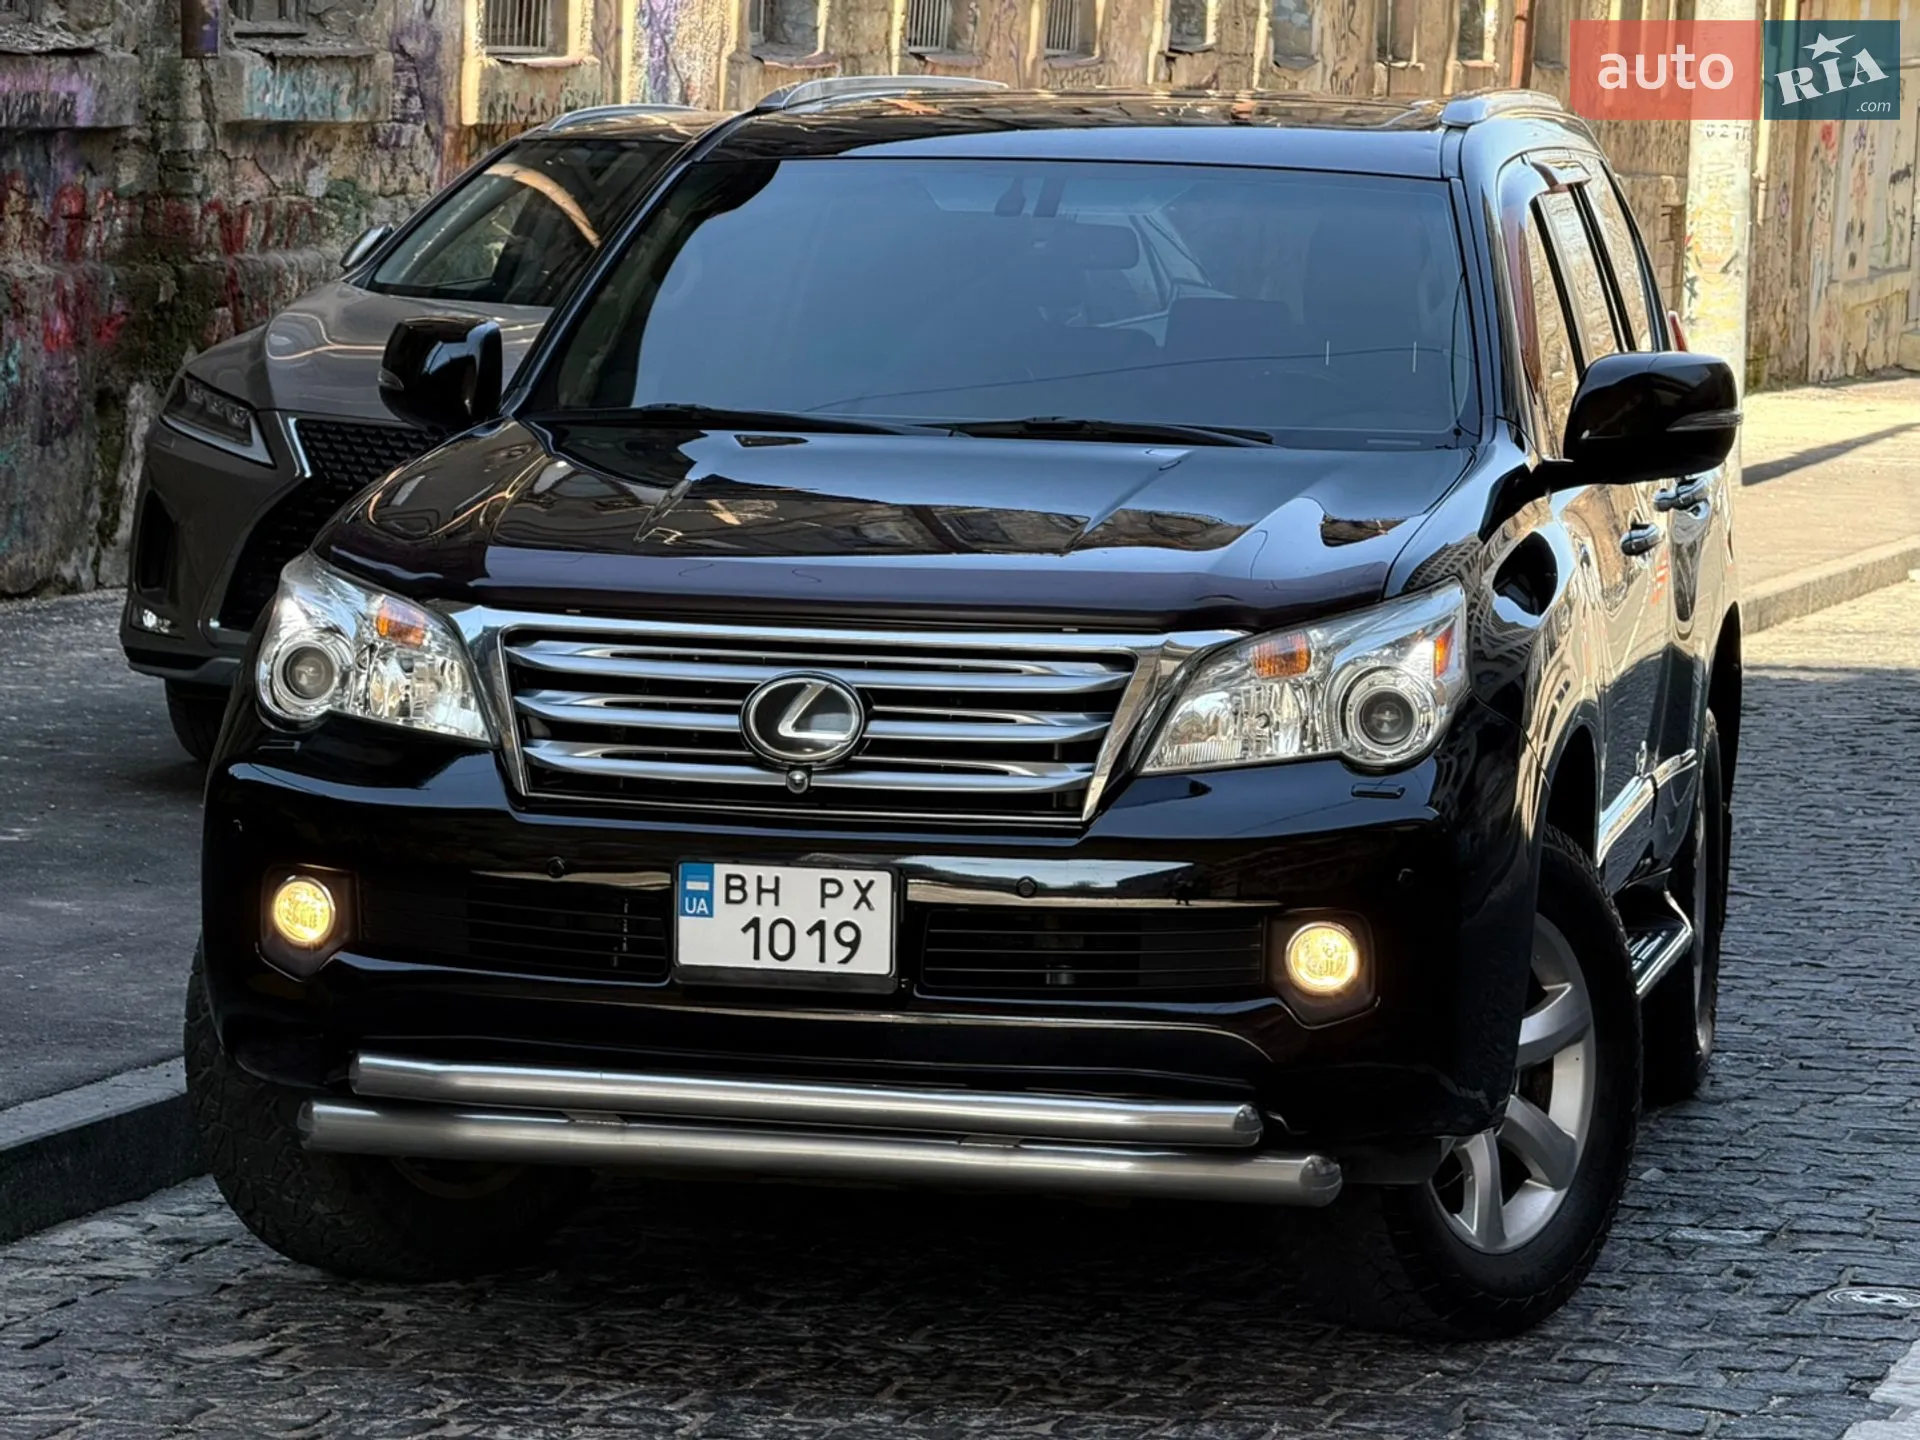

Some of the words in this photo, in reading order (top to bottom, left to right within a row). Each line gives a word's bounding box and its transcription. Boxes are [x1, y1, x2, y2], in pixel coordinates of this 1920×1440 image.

[684, 897, 710, 915] UA
[724, 873, 782, 907] BH
[820, 877, 876, 911] PX
[740, 916, 862, 965] 1019
